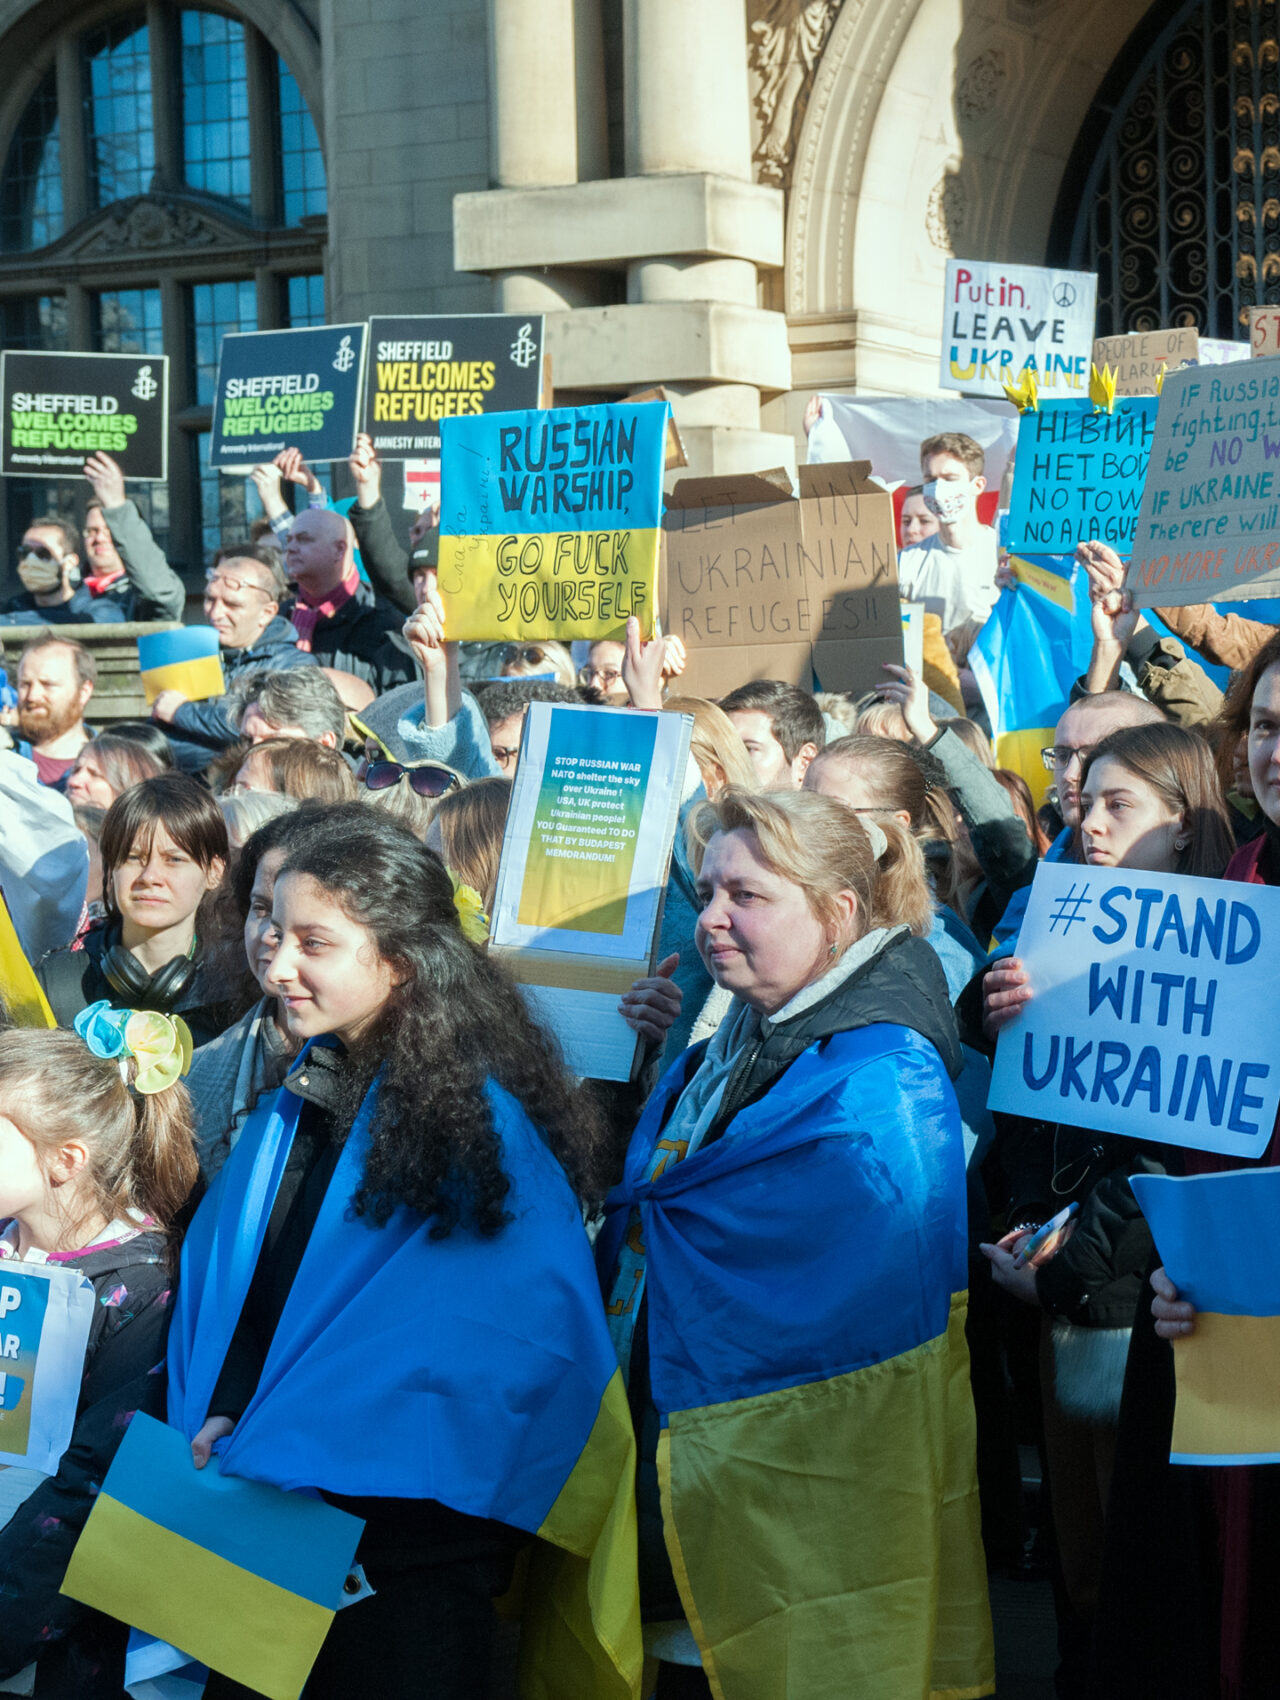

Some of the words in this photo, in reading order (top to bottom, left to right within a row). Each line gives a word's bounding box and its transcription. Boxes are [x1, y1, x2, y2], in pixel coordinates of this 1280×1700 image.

[954, 268, 1031, 310] Putin,
[952, 311, 1065, 343] LEAVE
[377, 341, 453, 361] SHEFFIELD
[1096, 335, 1150, 361] PEOPLE
[1167, 332, 1188, 353] OF
[376, 361, 496, 391] WELCOMES
[950, 346, 1087, 389] UKRAINE
[225, 373, 319, 398] SHEFFIELD
[1180, 384, 1201, 408] IF
[11, 392, 119, 415] SHEFFIELD
[224, 391, 334, 417] WELCOMES
[374, 392, 484, 422] REFUGEES
[11, 411, 138, 434] WELCOMES
[222, 411, 324, 437] REFUGEES
[11, 429, 128, 452] REFUGEES
[374, 436, 414, 449] AMNESTY
[500, 416, 637, 472] RUSSIAN
[1164, 448, 1189, 473] be
[1209, 436, 1243, 468] NO
[498, 469, 634, 515] WARSHIP,
[677, 492, 737, 533] LET
[811, 475, 859, 527] IN
[1030, 487, 1069, 513] NO
[1077, 487, 1113, 512] TO
[1151, 491, 1170, 515] IF
[1180, 472, 1274, 510] UKRAINE
[1239, 504, 1278, 532] will
[1024, 521, 1054, 544] NO
[496, 536, 544, 576] GO
[553, 532, 630, 575] FUCK
[678, 537, 890, 594] UKRAINIAN
[1136, 555, 1169, 588] NO
[1169, 548, 1228, 584] MORE
[497, 580, 646, 623] YOURSELF
[682, 598, 878, 640] REFUGEES!!
[551, 769, 575, 780] NATO
[576, 772, 606, 783] shelter
[608, 774, 623, 784] the
[624, 777, 640, 787] sky
[555, 757, 578, 766] STOP
[579, 759, 619, 770] RUSSIAN
[620, 762, 641, 772] WAR
[557, 796, 576, 807] USA,
[577, 798, 591, 807] UK
[591, 800, 625, 810] protect
[563, 785, 583, 793] over
[584, 785, 618, 796] Ukraine
[537, 820, 555, 829] YOU
[555, 822, 607, 835] Guaranteed
[608, 827, 620, 837] TO
[621, 829, 636, 838] DO
[551, 809, 591, 820] Ukrainian
[592, 813, 626, 824] people!
[541, 834, 563, 844] THAT
[564, 836, 577, 845] BY
[578, 838, 626, 850] BUDAPEST
[545, 848, 616, 863] MEMORANDUM!
[1048, 882, 1261, 965] #STAND
[1088, 961, 1218, 1037] WITH
[1022, 1030, 1270, 1136] UKRAINE
